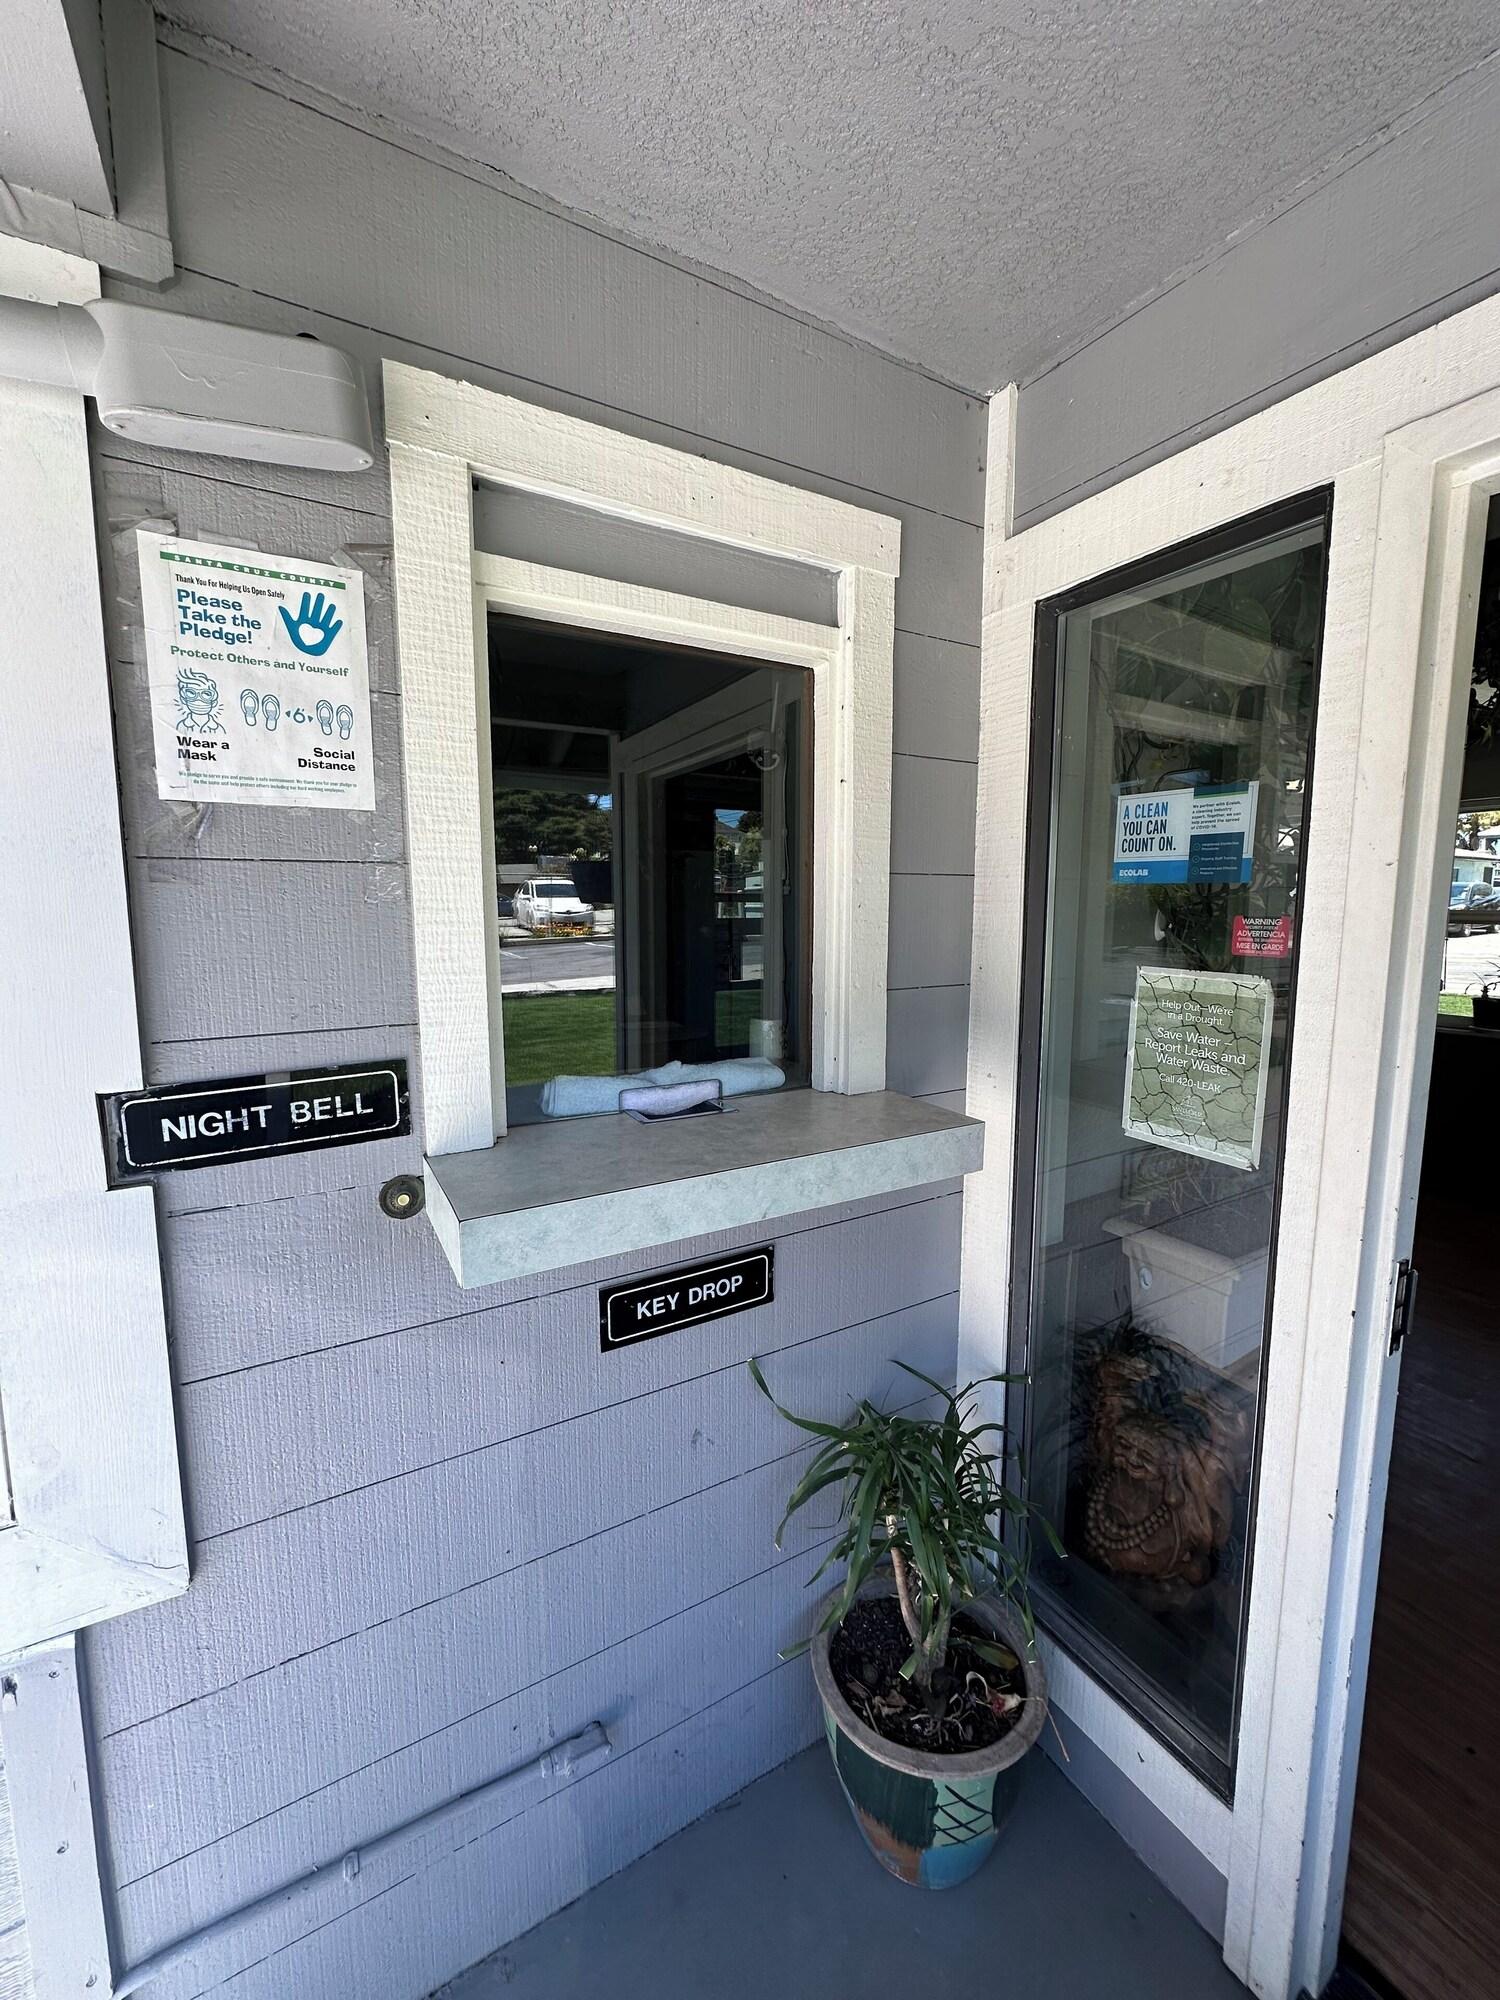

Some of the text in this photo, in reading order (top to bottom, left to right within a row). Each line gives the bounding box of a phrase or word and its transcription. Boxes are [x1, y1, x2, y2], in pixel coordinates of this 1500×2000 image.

[175, 555, 336, 586] SANTA CRUZ COUNTY
[176, 574, 285, 600] Thank You For Helping Us Open Safely
[177, 589, 242, 611] Please
[178, 605, 262, 629] Take the
[180, 621, 252, 645] Pledge!
[170, 645, 349, 677] Protect Others and Yourself
[176, 736, 230, 750] Wear a
[178, 749, 216, 761] Mask
[314, 747, 355, 760] Social
[298, 758, 356, 772] Distance
[1124, 802, 1168, 819] A CLEAN
[1123, 819, 1167, 836] YOU CAN
[1122, 836, 1176, 853] COUNT ON.
[1162, 1000, 1181, 1010] Help
[1185, 1013, 1224, 1026] Drought.
[1157, 1027, 1182, 1041] Save
[1186, 1032, 1221, 1047] Water
[1145, 1038, 1246, 1065] Report Leaks and
[1156, 1052, 1230, 1076] Water Waste.
[1159, 1073, 1221, 1092] Call 420-LEAK
[161, 1093, 374, 1142] NIGHT BELL
[637, 1275, 743, 1320] KEY DROP
